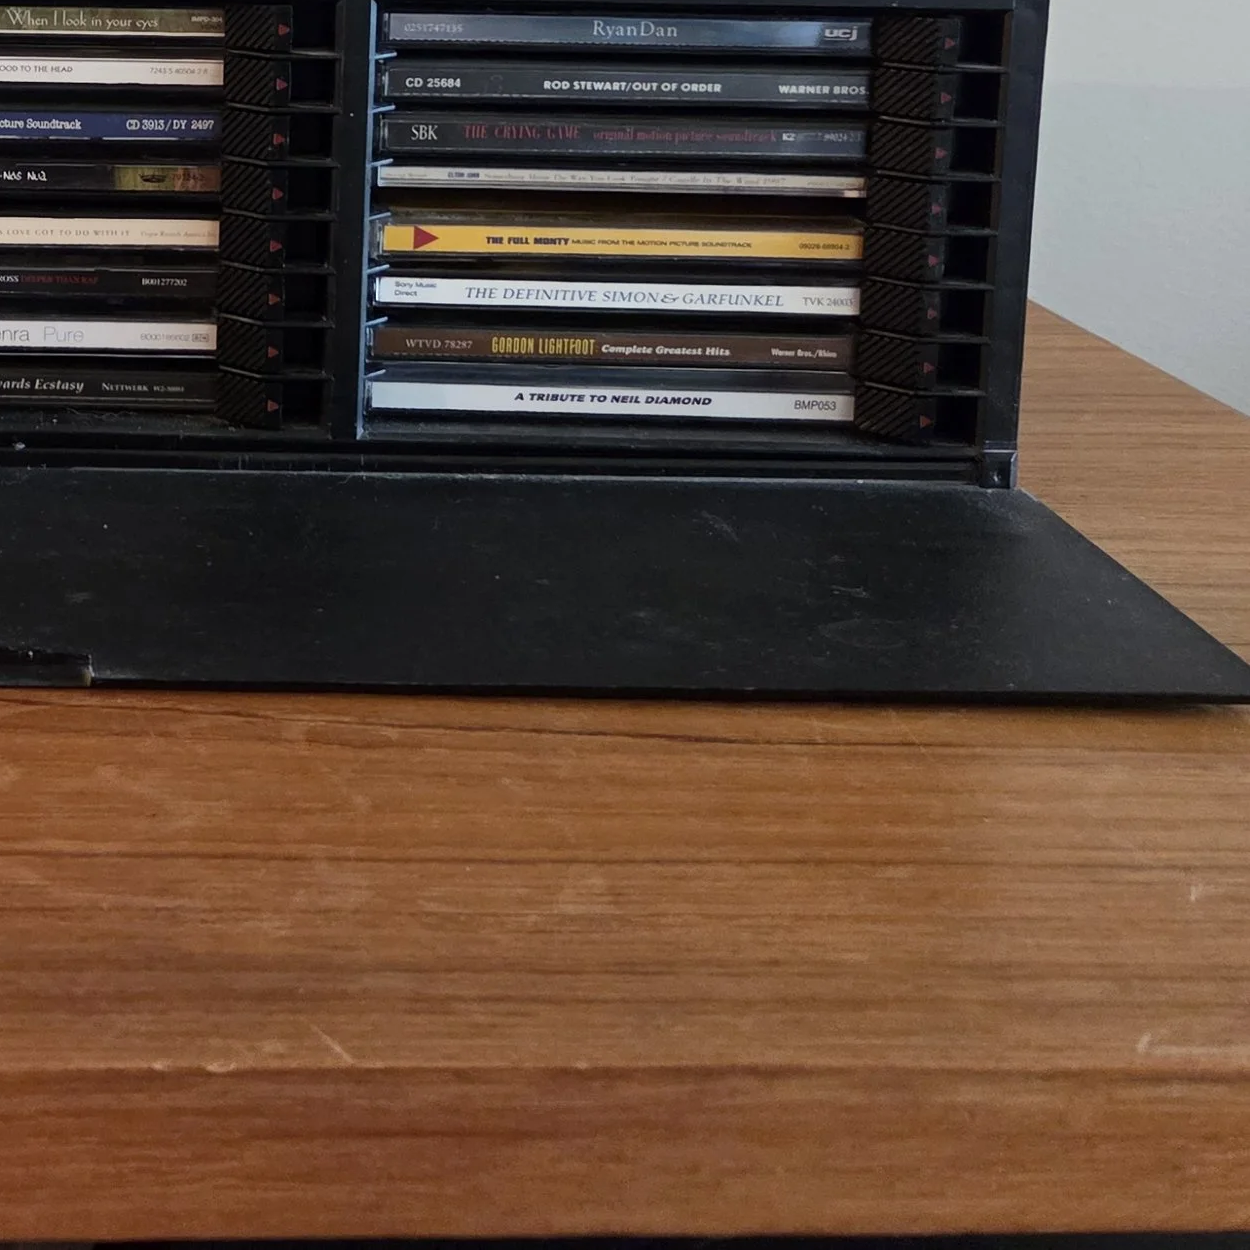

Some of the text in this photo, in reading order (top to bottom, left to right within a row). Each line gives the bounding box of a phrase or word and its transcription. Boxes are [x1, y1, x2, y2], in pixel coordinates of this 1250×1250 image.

[6, 7, 48, 27] When
[54, 8, 57, 27] I
[62, 9, 87, 27] look
[91, 16, 102, 28] in
[106, 17, 132, 30] your
[135, 16, 159, 30] eyes
[592, 20, 678, 38] RyanDan
[824, 27, 858, 40] ucj
[50, 65, 73, 73] HEAD
[406, 78, 869, 95] CD 25684 ROD STEWART/OUT OF ORDER WARNER BROS.
[26, 118, 81, 130] Soundtrack
[126, 120, 139, 130] CD
[191, 120, 214, 130] 2497
[411, 125, 438, 141] SBK
[464, 124, 488, 139] THE
[494, 124, 541, 139] CRYING
[546, 125, 581, 139] GAME
[93, 229, 119, 237] WITH
[486, 236, 504, 245] THE
[508, 237, 529, 245] FULL
[533, 237, 569, 246] MONTY
[394, 281, 414, 289] Sony
[465, 286, 498, 299] THE
[502, 287, 597, 301] DEFINITIVE
[602, 290, 660, 303] SIMON
[682, 292, 784, 307] GARFUNKEL
[803, 297, 824, 306] TVK
[43, 326, 85, 343] Pure
[405, 338, 442, 349] WTVD
[443, 339, 473, 349] 78287
[491, 336, 534, 354] GORDON
[539, 338, 596, 355] LIGHTFOOT
[601, 344, 652, 355] Complete
[655, 345, 702, 355] Greatest
[705, 346, 731, 356] Hits
[34, 378, 85, 393] Ecstasy
[514, 392, 836, 411] A TRIBUTE TO NEIL DIAMOND BMP053
